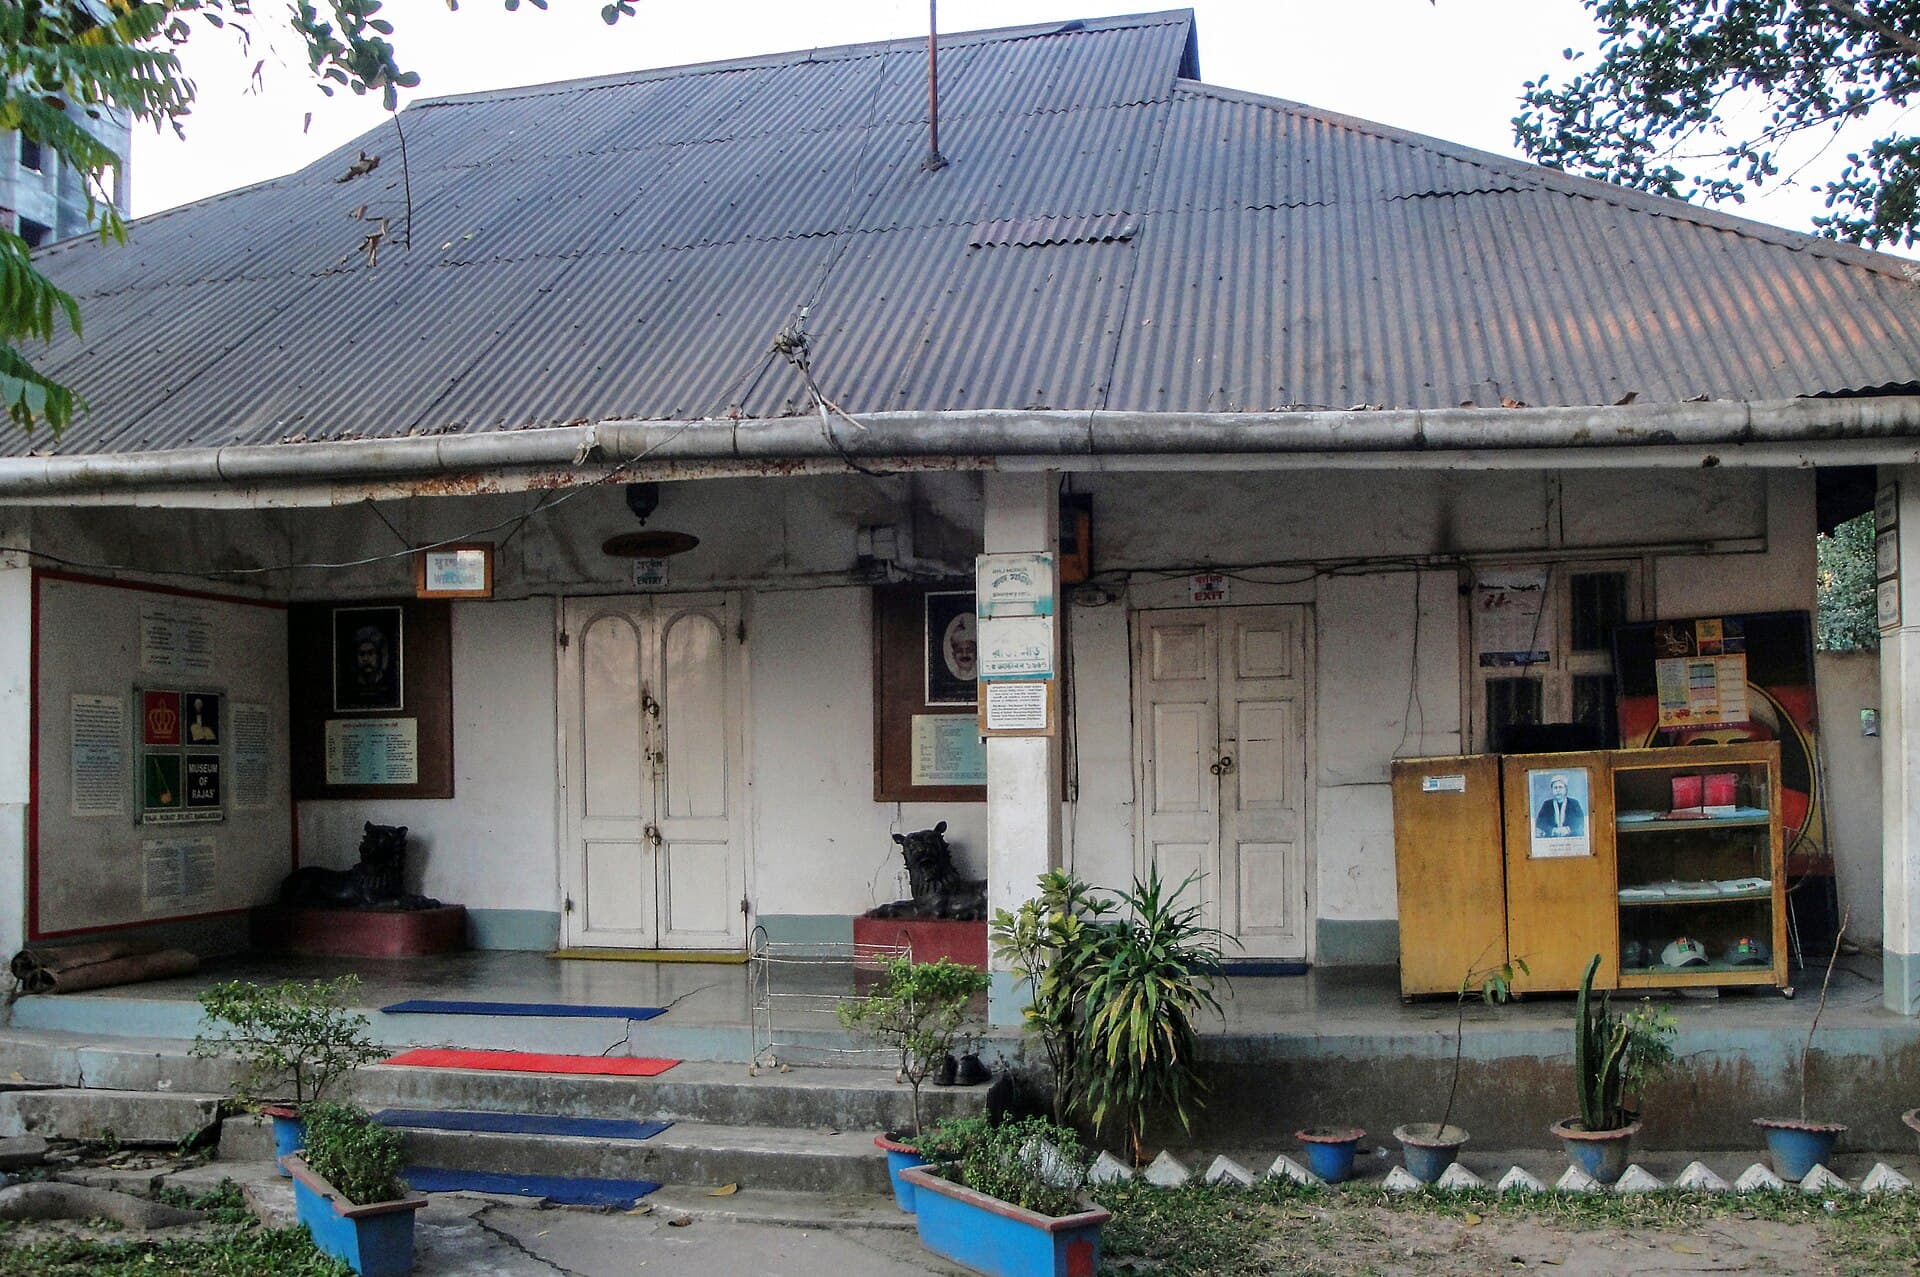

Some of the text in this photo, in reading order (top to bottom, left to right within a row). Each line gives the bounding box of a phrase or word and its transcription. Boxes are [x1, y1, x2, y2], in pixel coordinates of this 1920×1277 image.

[637, 576, 663, 585] ENTRY
[1194, 591, 1224, 601] EXIT
[188, 763, 218, 774] MUSEUM
[199, 776, 208, 786] OF
